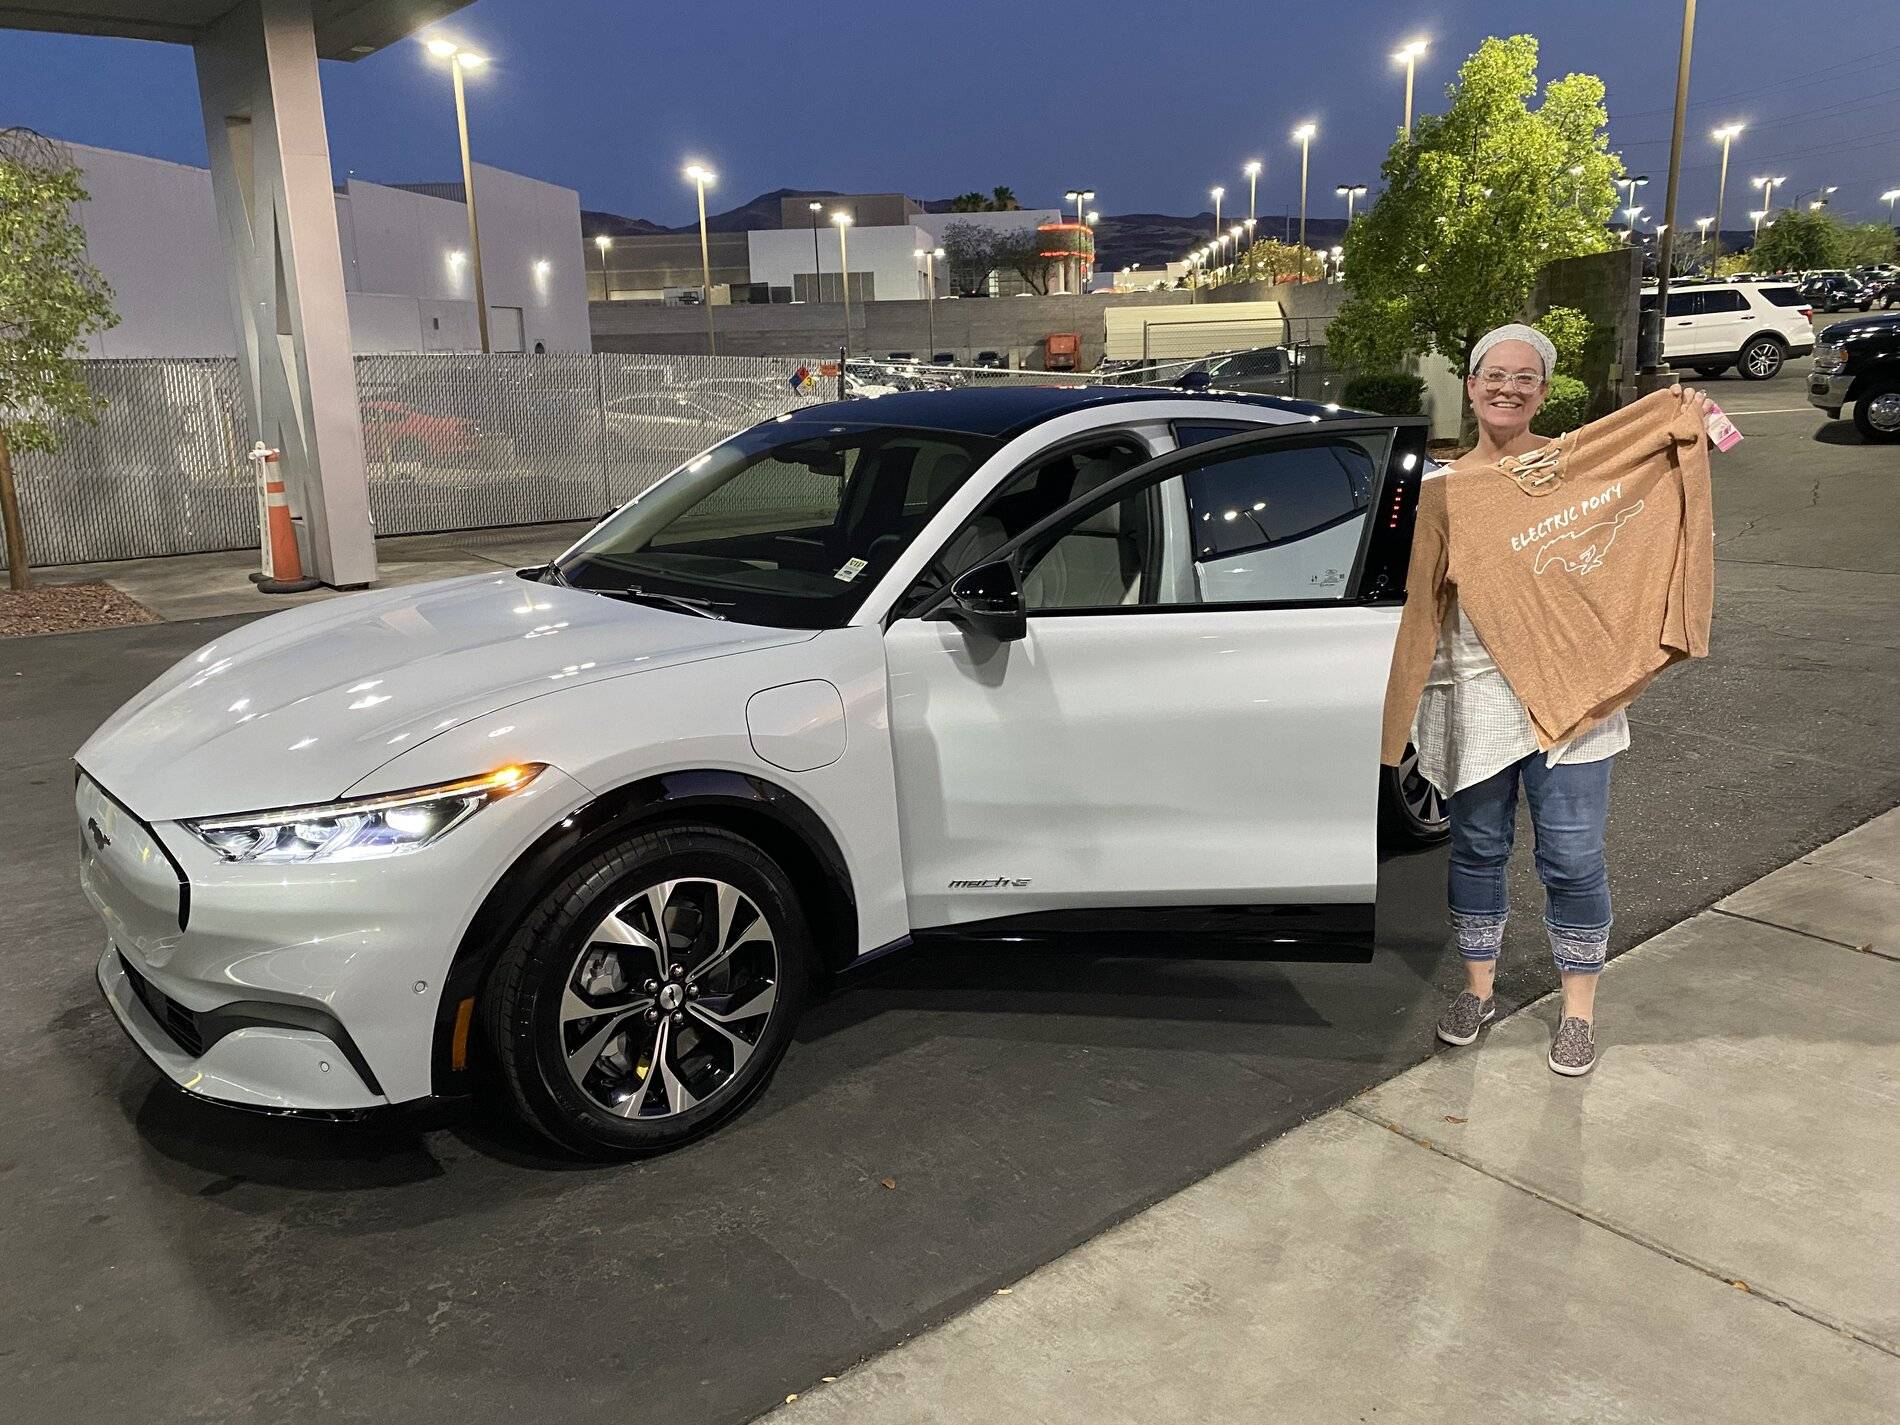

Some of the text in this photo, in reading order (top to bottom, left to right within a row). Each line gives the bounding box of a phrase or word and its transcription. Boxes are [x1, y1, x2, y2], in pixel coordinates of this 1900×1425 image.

[806, 377, 812, 387] 3
[1510, 482, 1622, 552] ELECTRIC PONY
